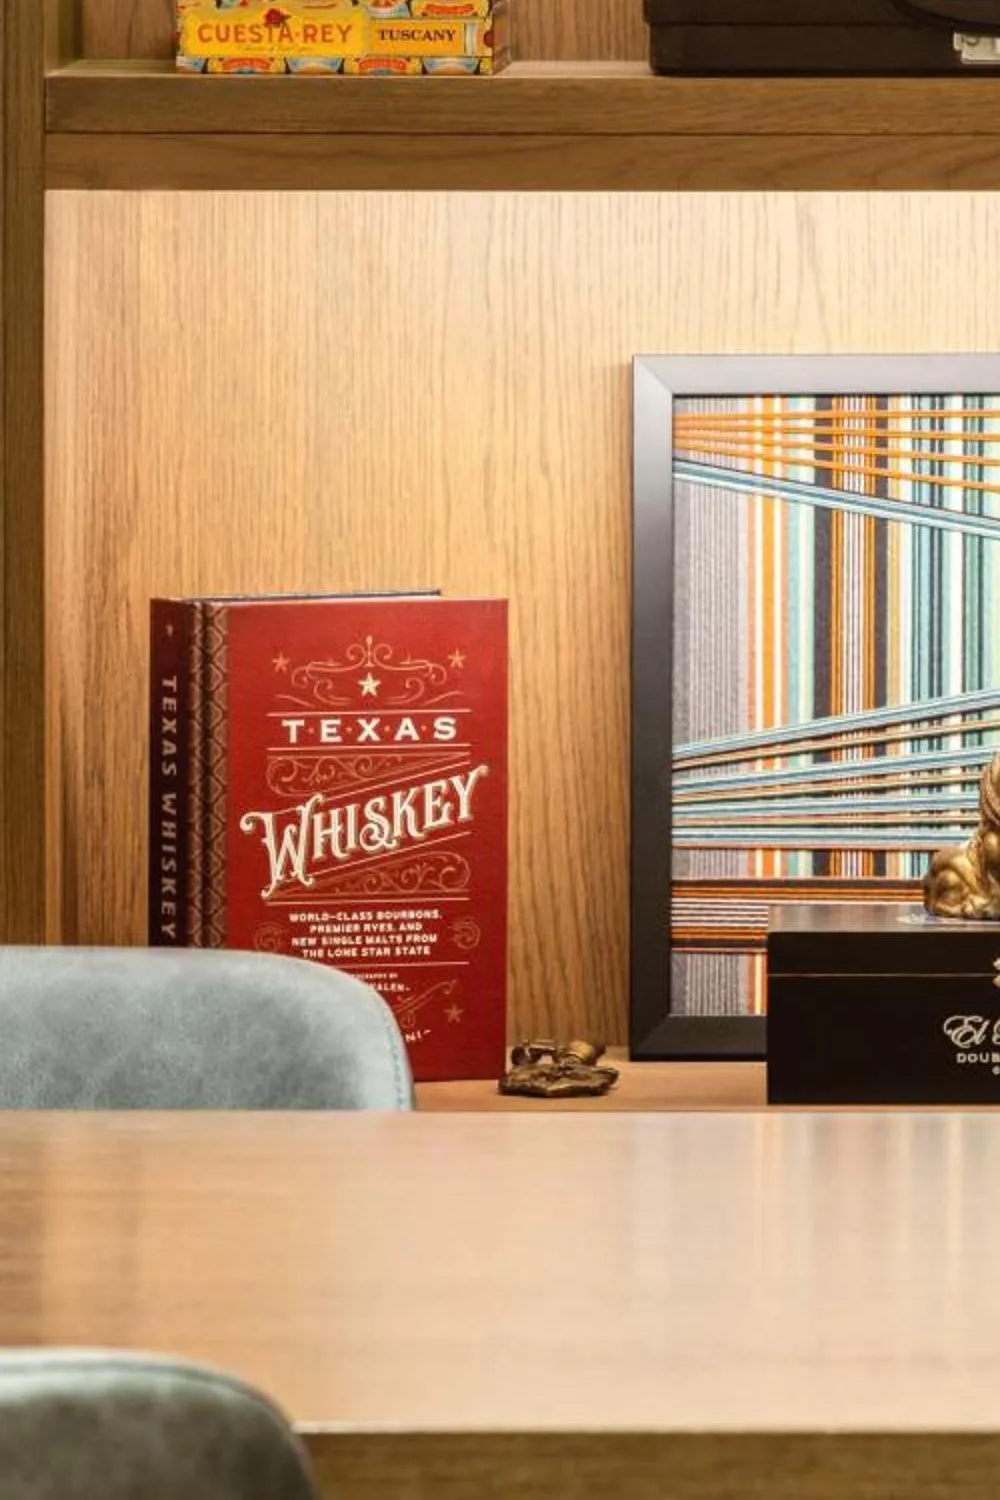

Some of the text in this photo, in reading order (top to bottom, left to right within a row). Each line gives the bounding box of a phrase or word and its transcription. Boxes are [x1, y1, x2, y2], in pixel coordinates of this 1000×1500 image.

[378, 28, 457, 42] TUSCANY
[160, 674, 178, 939] TEXAS WHISKEY
[240, 765, 489, 900] WHISKEY
[289, 911, 374, 923] WORLD-CLASS
[310, 923, 361, 933] PREMIER
[399, 921, 423, 932] AND
[291, 933, 438, 946] NEW SINGLE MALTS FROM
[302, 945, 431, 959] THE LONE STAR STATE
[943, 1015, 991, 1049] El
